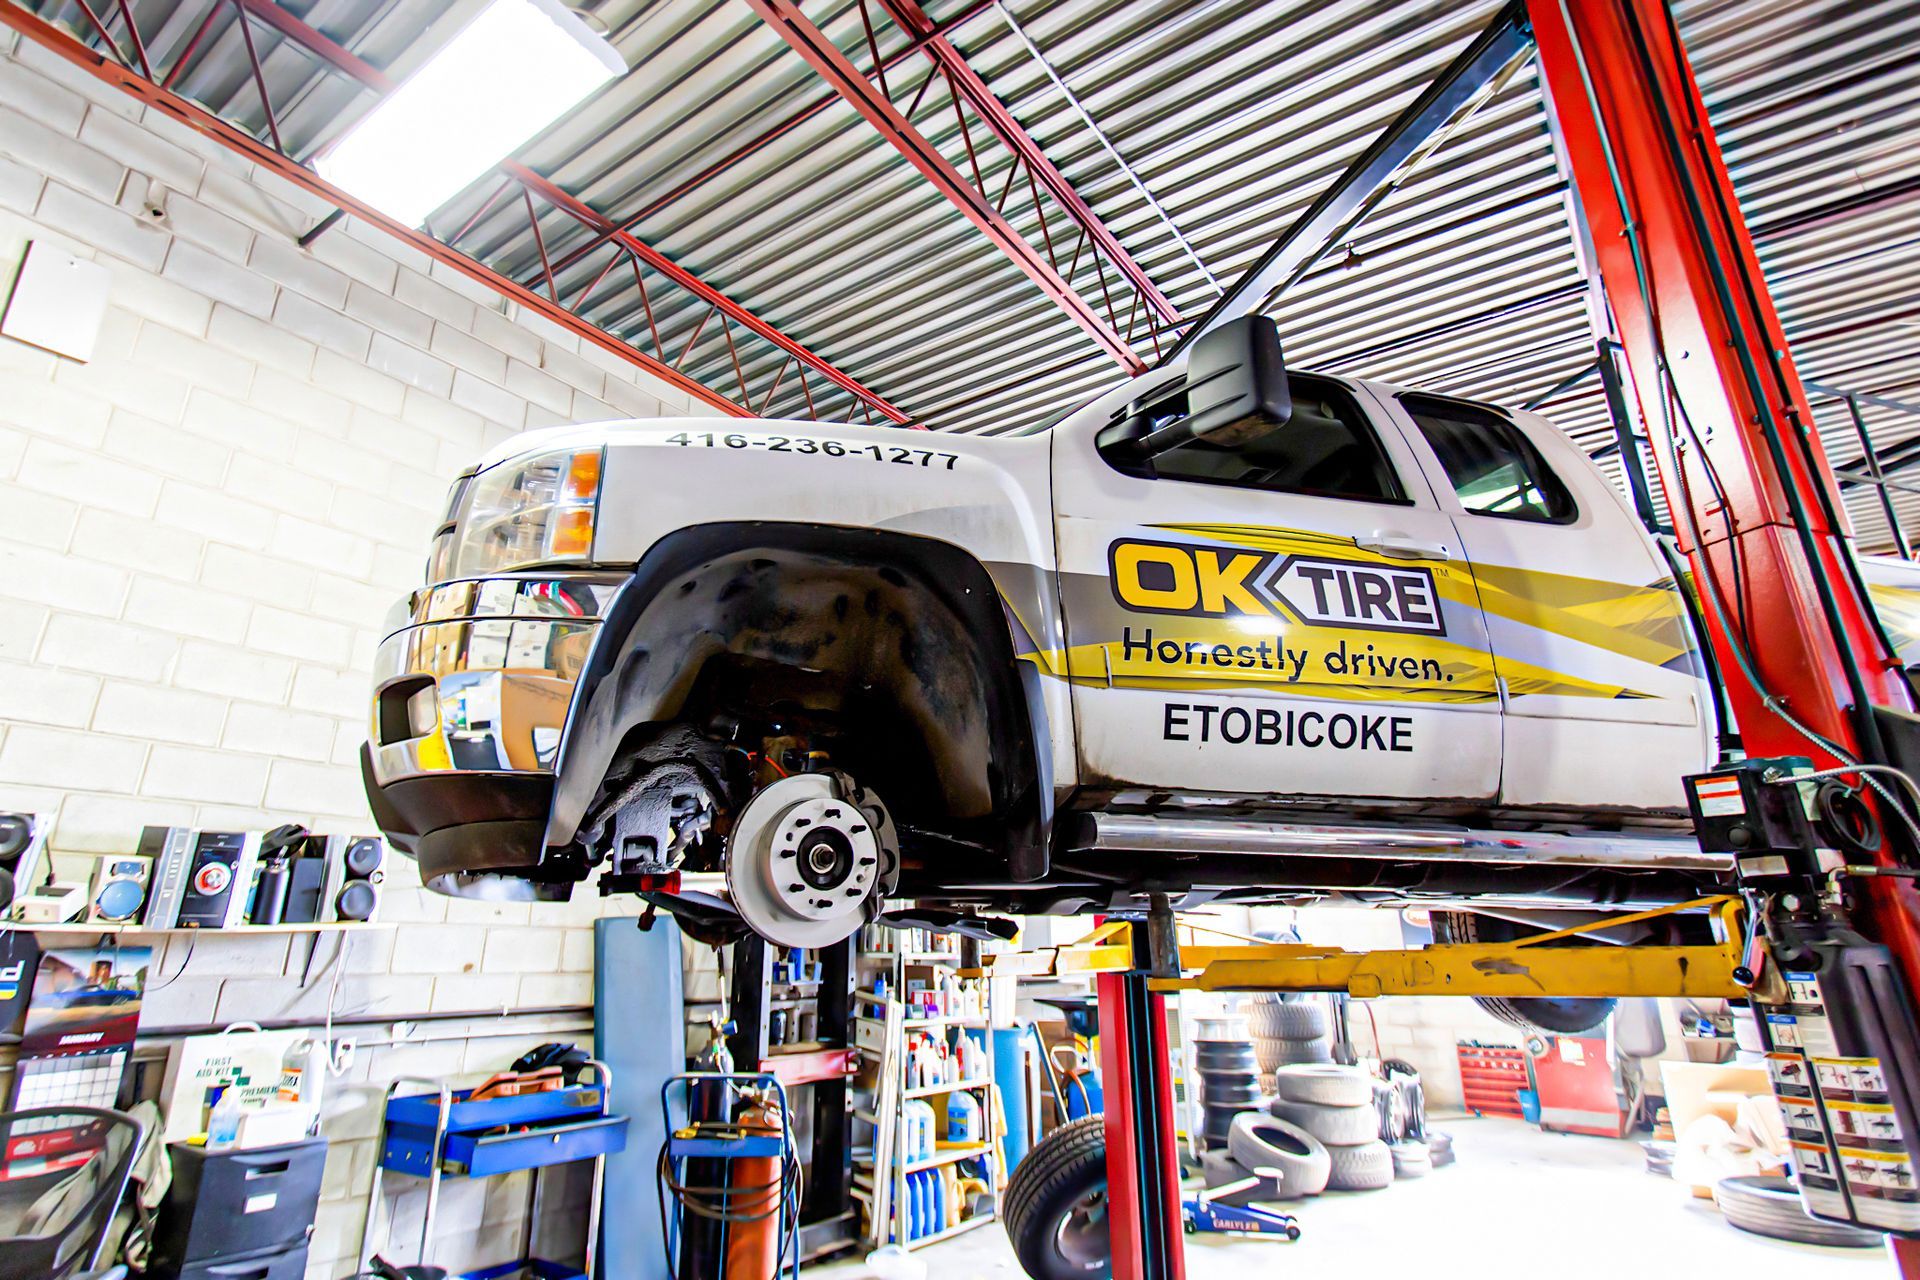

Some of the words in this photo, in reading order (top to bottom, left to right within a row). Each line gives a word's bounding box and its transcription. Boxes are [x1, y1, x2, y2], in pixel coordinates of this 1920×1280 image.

[665, 432, 959, 470] 416-236-1277
[1115, 543, 1272, 615] OK
[1296, 566, 1434, 624] TIRE
[1123, 627, 1308, 682] Honestly
[1324, 640, 1453, 682] driven.
[1163, 703, 1414, 752] ETOBICOKE
[196, 1068, 211, 1078] AID
[215, 1067, 229, 1076] KIT
[205, 1057, 231, 1066] FIRST
